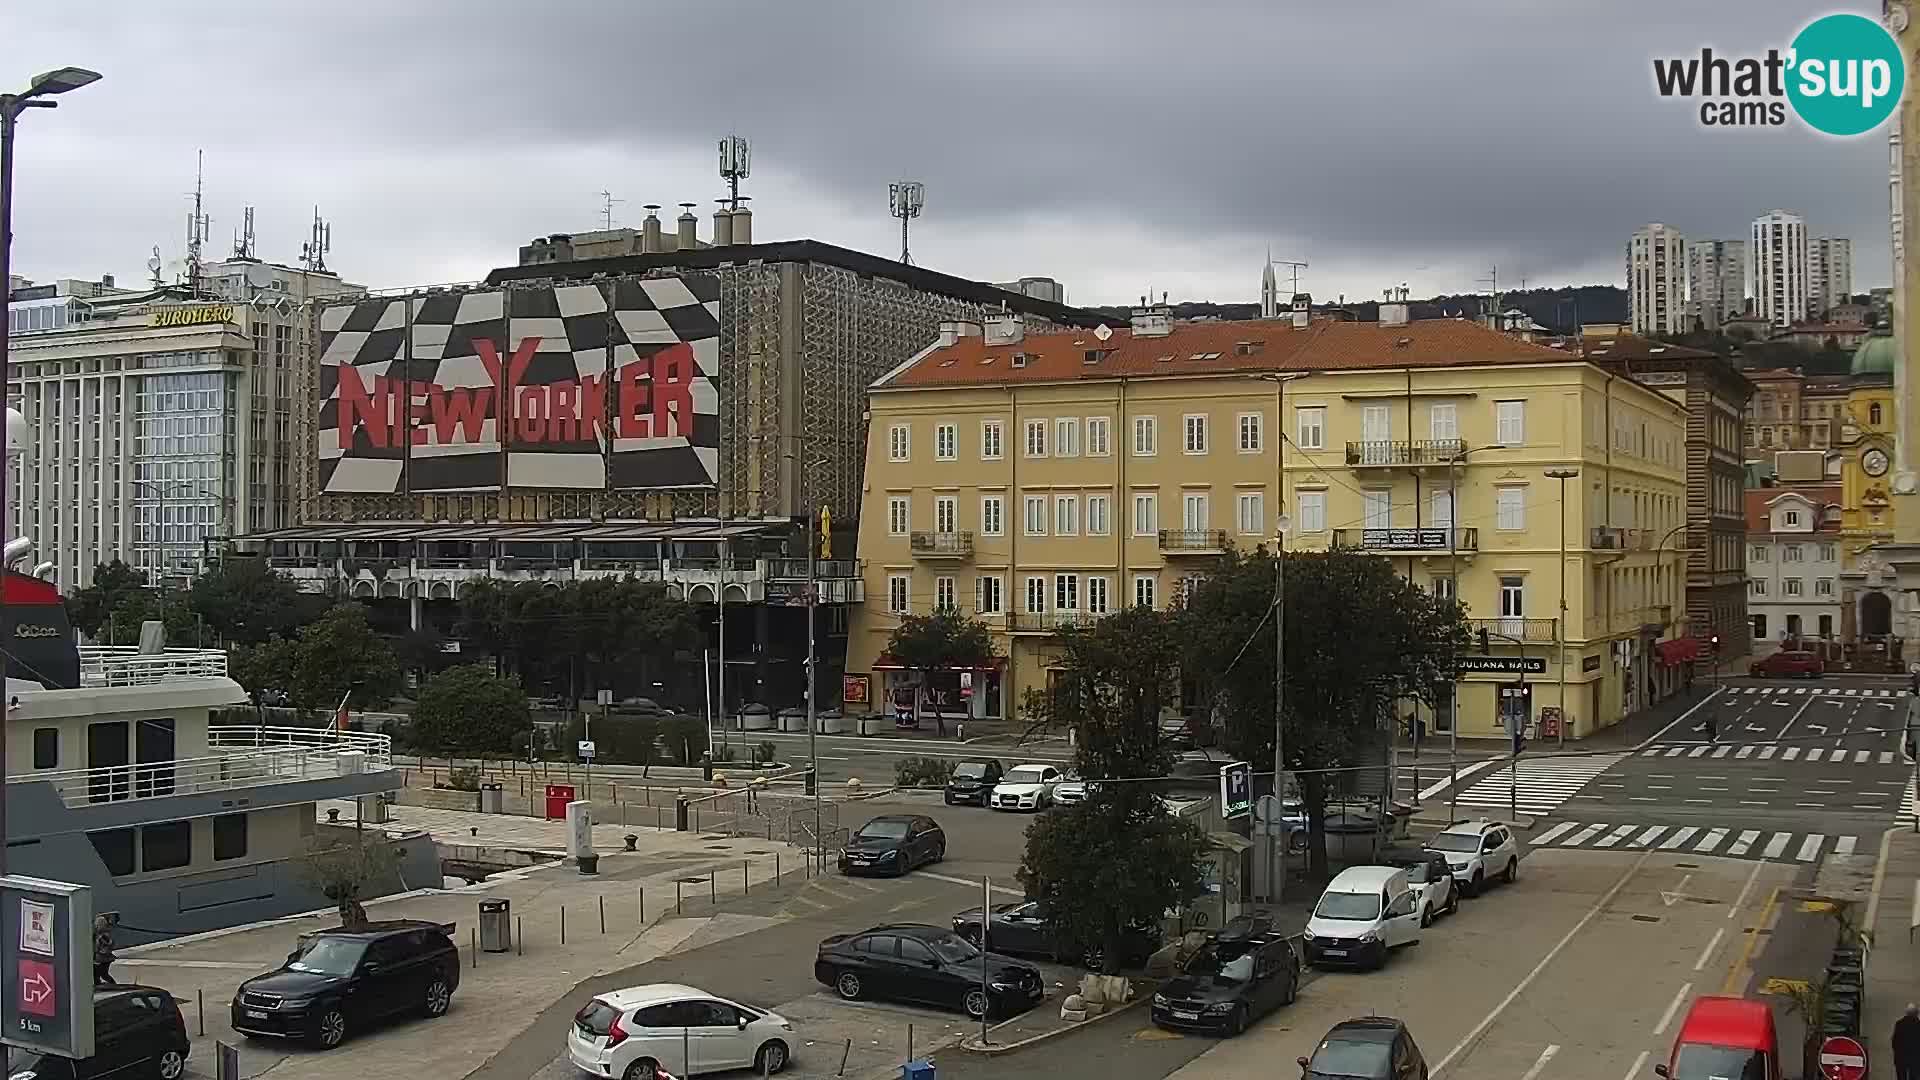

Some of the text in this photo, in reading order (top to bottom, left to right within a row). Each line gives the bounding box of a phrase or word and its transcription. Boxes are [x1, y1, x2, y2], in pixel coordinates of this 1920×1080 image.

[1459, 661, 1541, 670] JULIANA NAILS
[20, 1018, 41, 1033] 5 km
